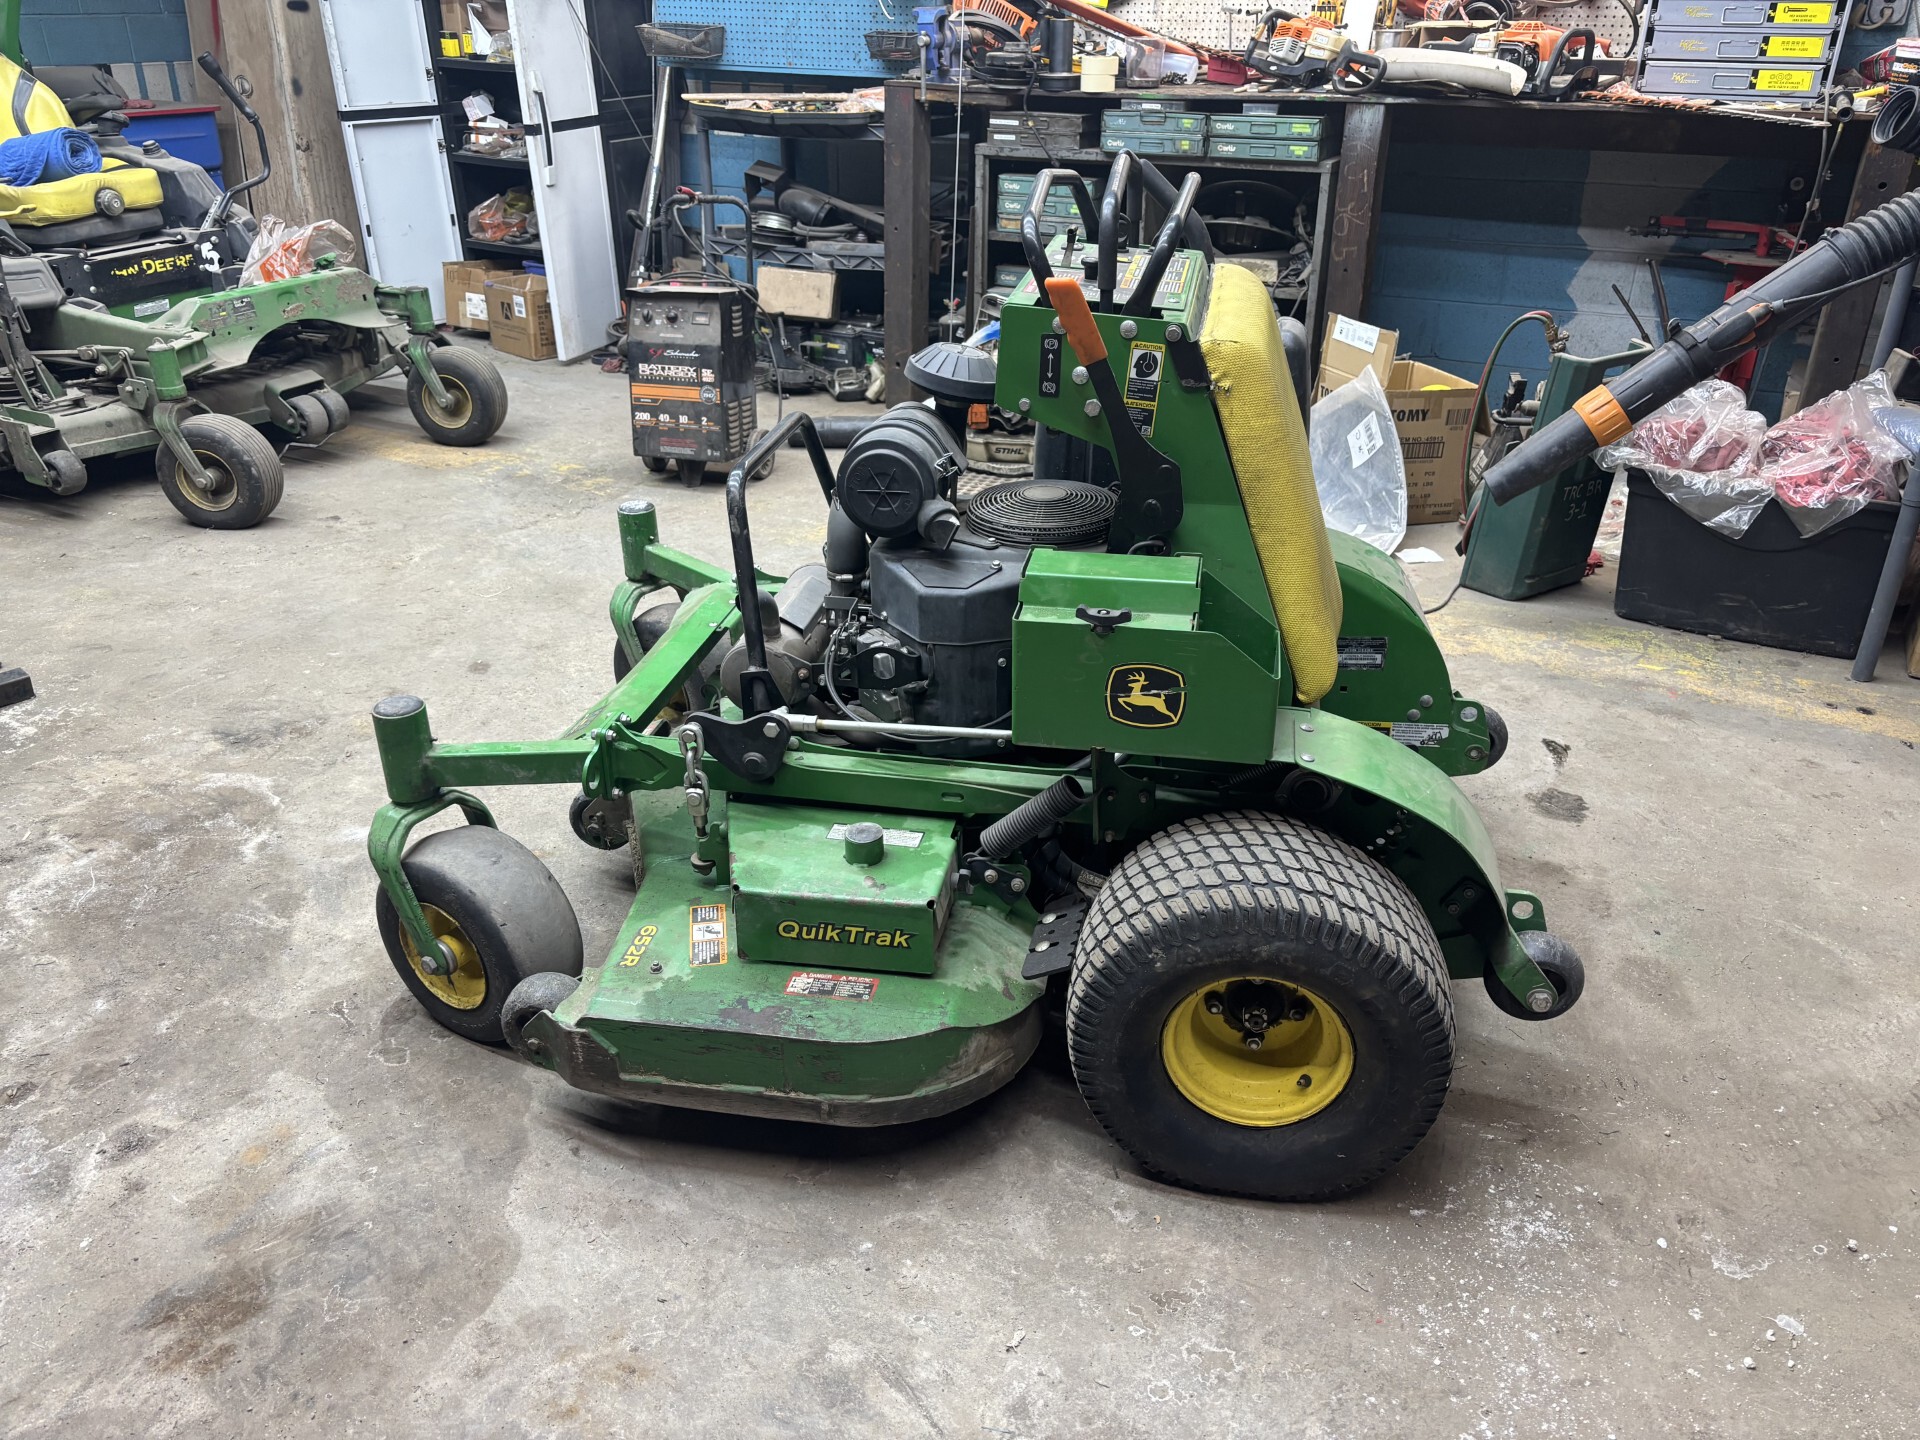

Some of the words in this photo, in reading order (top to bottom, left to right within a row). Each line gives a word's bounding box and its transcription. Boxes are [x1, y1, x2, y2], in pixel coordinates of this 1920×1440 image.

[1138, 343, 1163, 351] CAUTION
[638, 363, 697, 372] BATTERY
[639, 368, 697, 378] CHARGER
[634, 411, 651, 421] 200
[678, 415, 689, 424] 10
[701, 416, 708, 426] 2
[994, 447, 1025, 455] STIHL
[778, 920, 911, 948] QuikTrak
[620, 924, 659, 968] 652R
